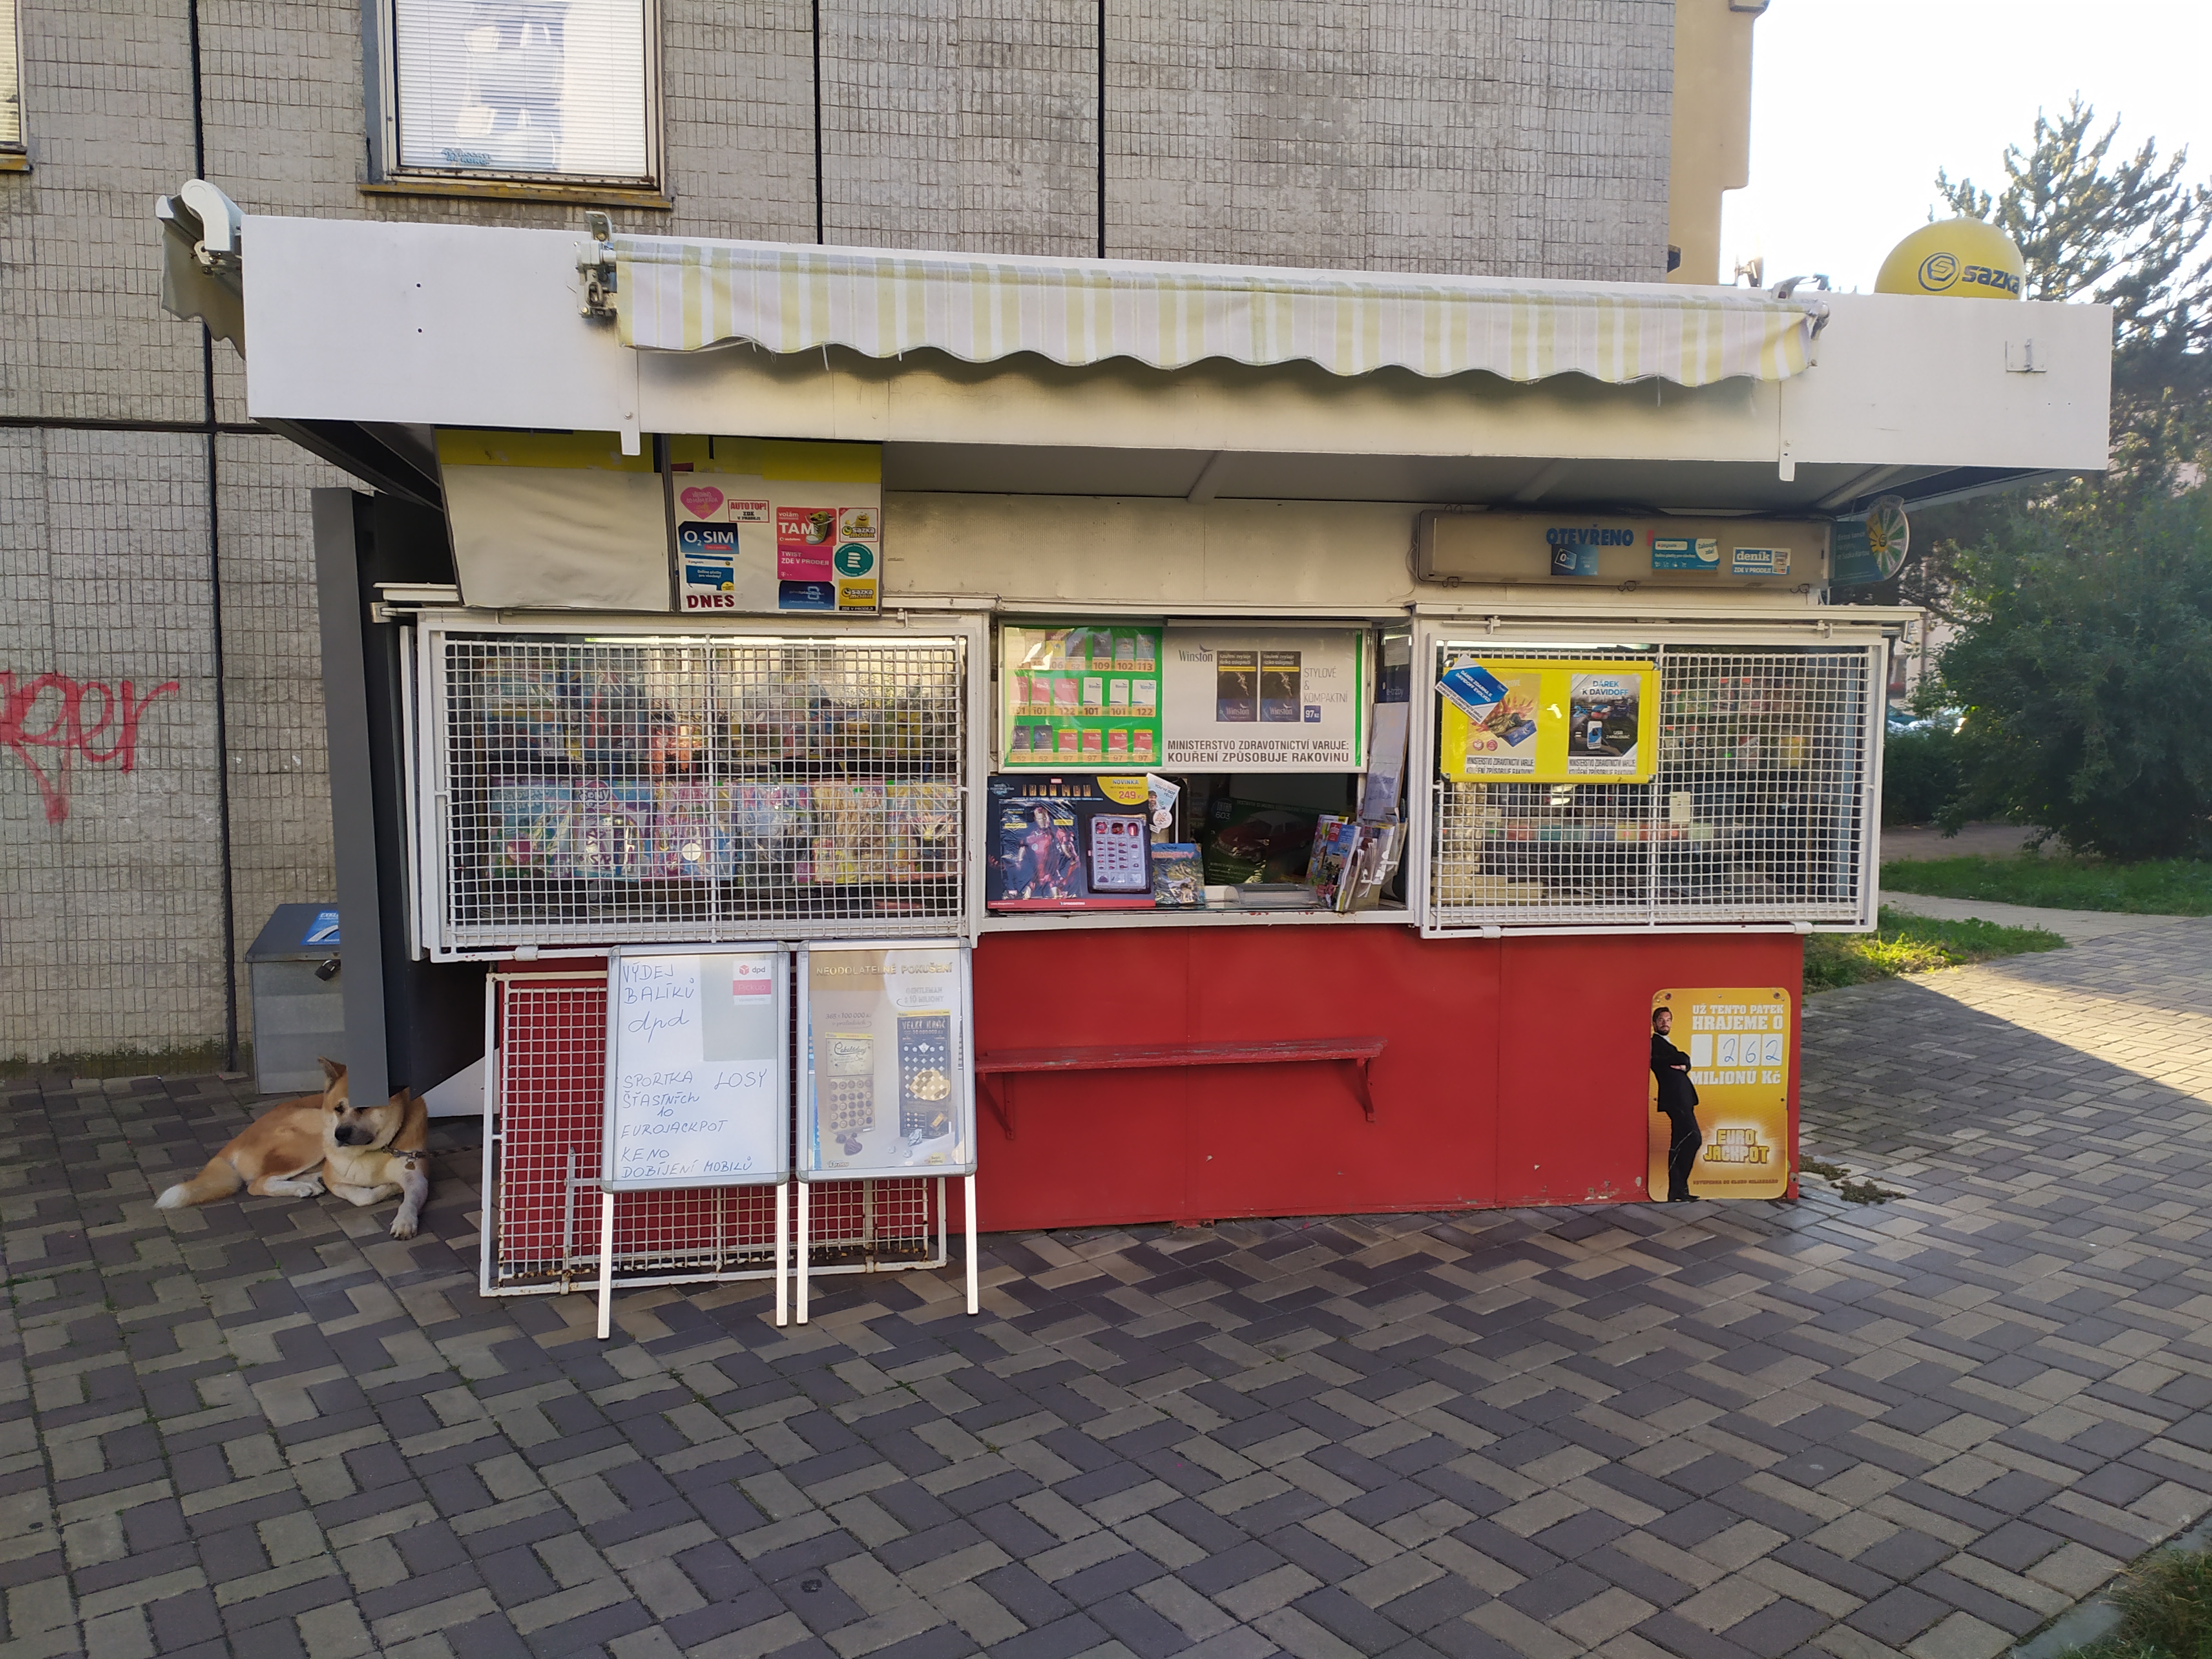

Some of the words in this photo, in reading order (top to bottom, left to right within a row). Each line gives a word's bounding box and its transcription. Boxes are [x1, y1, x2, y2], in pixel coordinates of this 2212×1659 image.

[779, 523, 815, 535] TAM
[1546, 524, 1634, 546] OTEVŘENO
[703, 531, 734, 544] SIM
[1736, 549, 1770, 562] deník
[686, 594, 735, 608] DNES
[1178, 649, 1213, 662] Winston
[1093, 661, 1110, 670] 109
[1138, 662, 1153, 671] 113
[1304, 666, 1337, 678] STYLOVÉ
[1304, 680, 1310, 690] &
[1303, 691, 1348, 703] KOMPAKTNÍ
[1226, 706, 1249, 715] Winston
[1270, 706, 1293, 715] Winston
[1305, 710, 1314, 718] 97
[1167, 740, 1235, 750] MINISTERSTVO
[1239, 738, 1310, 750] ZDRAVOTNICTVÍ
[1313, 740, 1349, 750] VARUJE:
[1167, 750, 1219, 763] KOUŘENÍ
[1222, 750, 1287, 763] ZPŮSOBUJE
[1292, 752, 1349, 763] RAKOVINU
[1119, 791, 1136, 799] 249
[1215, 811, 1231, 820] 603
[623, 961, 674, 983] VÝDEJ
[816, 963, 896, 977] NEODOLATELNÉ
[901, 961, 953, 974] POKUŠENÍ
[624, 977, 695, 1004] BALÍKŮ
[910, 995, 917, 1004] 10
[1693, 1003, 1707, 1014] UŽ
[1710, 1005, 1746, 1014] TENTO
[1750, 1003, 1783, 1014] PÁTEK
[628, 1009, 690, 1044] dpd
[1692, 1015, 1768, 1031] HRAJEME
[1773, 1016, 1783, 1030] O
[623, 1071, 693, 1088] SPORTKA
[714, 1068, 767, 1090] LOSY
[1691, 1067, 1756, 1086] MILIONŮ
[1761, 1071, 1781, 1084] Kč
[657, 1106, 674, 1117] 10
[621, 1120, 728, 1139] EUROJACKPOT
[1717, 1128, 1757, 1146] EURO
[1704, 1145, 1770, 1165] JACKPOT
